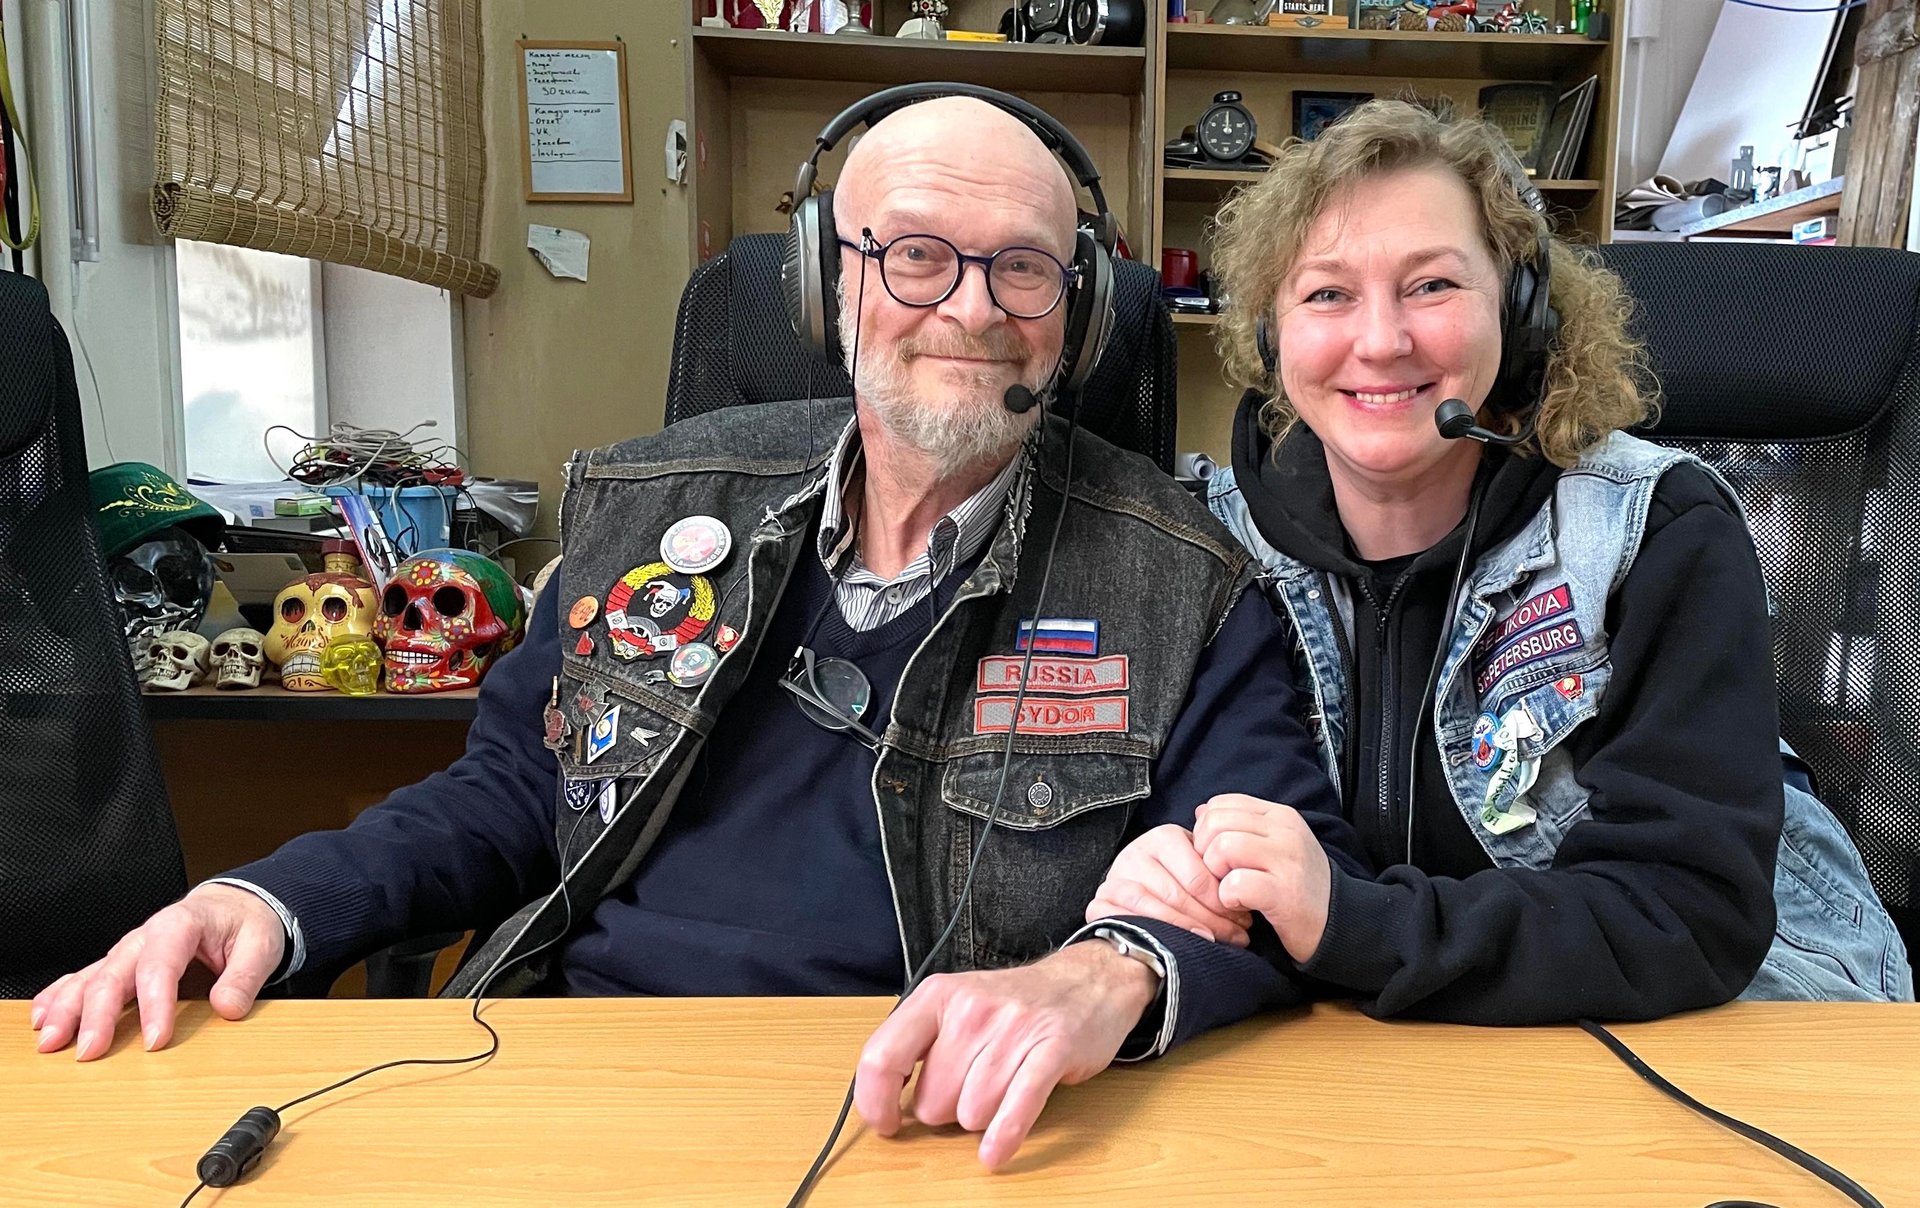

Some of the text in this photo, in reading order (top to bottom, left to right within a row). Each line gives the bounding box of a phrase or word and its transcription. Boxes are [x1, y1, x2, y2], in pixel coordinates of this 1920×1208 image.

[1283, 2, 1306, 11] STARTS
[1477, 625, 1577, 694] ST-PETERSBURG
[1005, 664, 1097, 684] RUSSIA
[1010, 706, 1096, 725] SYDOR
